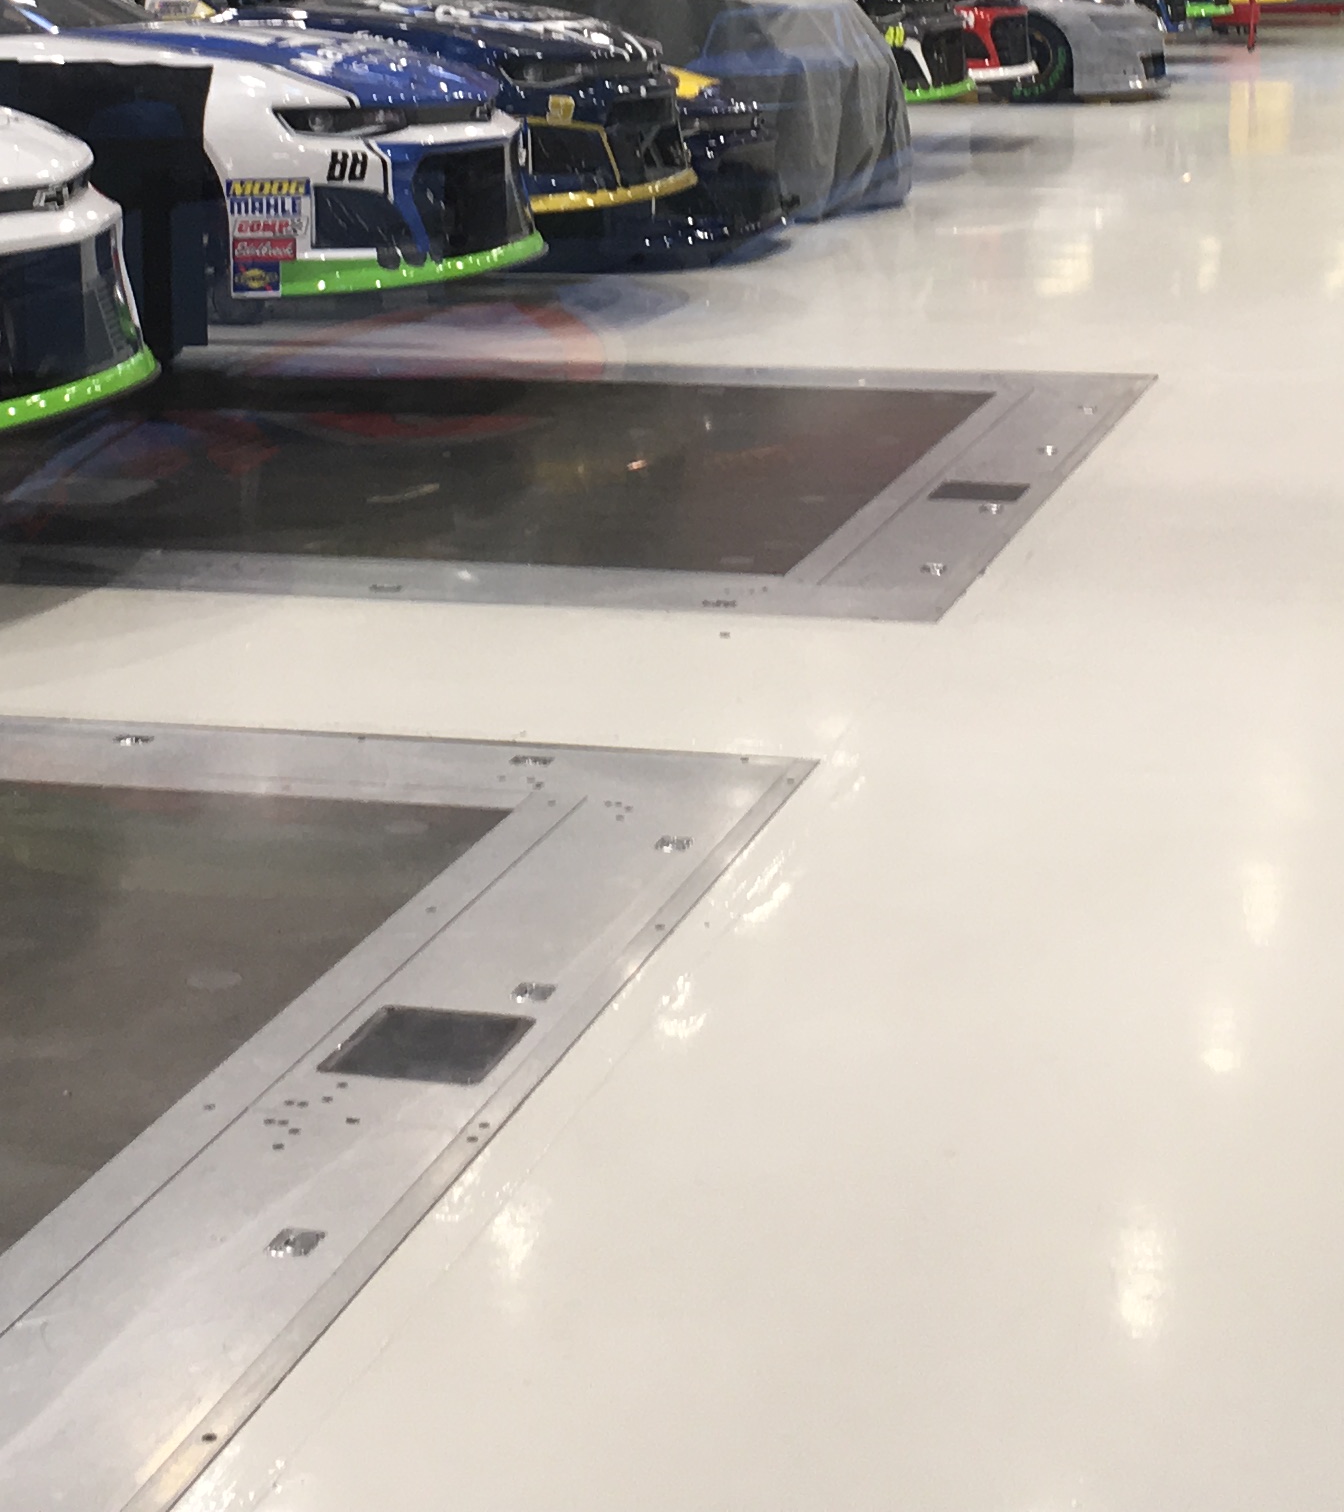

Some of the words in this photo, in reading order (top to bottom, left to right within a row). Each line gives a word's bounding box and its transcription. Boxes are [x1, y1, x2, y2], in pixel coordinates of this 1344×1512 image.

[326, 151, 369, 182] 88
[230, 180, 306, 196] MOOG
[230, 197, 302, 215] MAHLE
[237, 220, 290, 234] COMP
